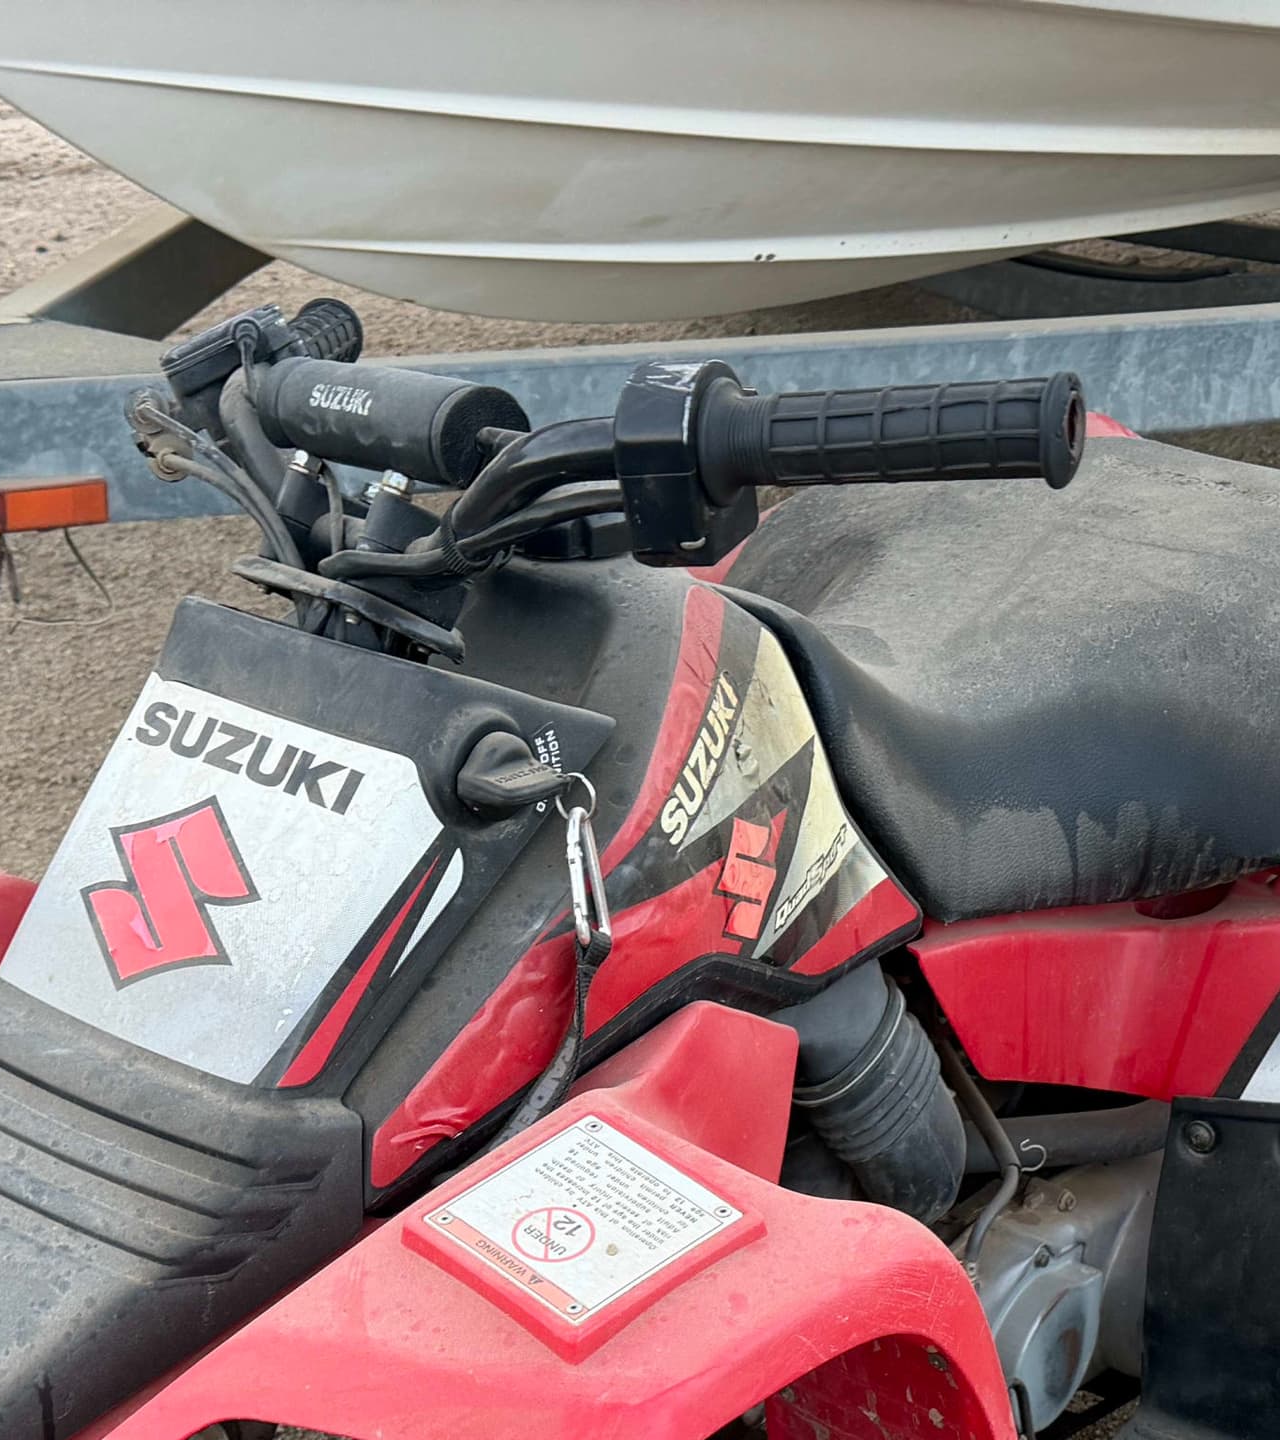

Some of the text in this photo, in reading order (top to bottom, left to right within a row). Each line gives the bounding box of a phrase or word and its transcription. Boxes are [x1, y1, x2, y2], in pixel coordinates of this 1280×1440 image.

[309, 383, 372, 416] SUZUKI
[135, 701, 365, 816] SUZUKI
[534, 736, 549, 763] OFF
[661, 671, 738, 845] SUZUKI
[576, 1197, 593, 1207] ATV
[669, 1203, 698, 1223] NEVER
[523, 1224, 567, 1256] UNDER
[548, 1215, 582, 1237] 12
[475, 1239, 527, 1276] WARNING
